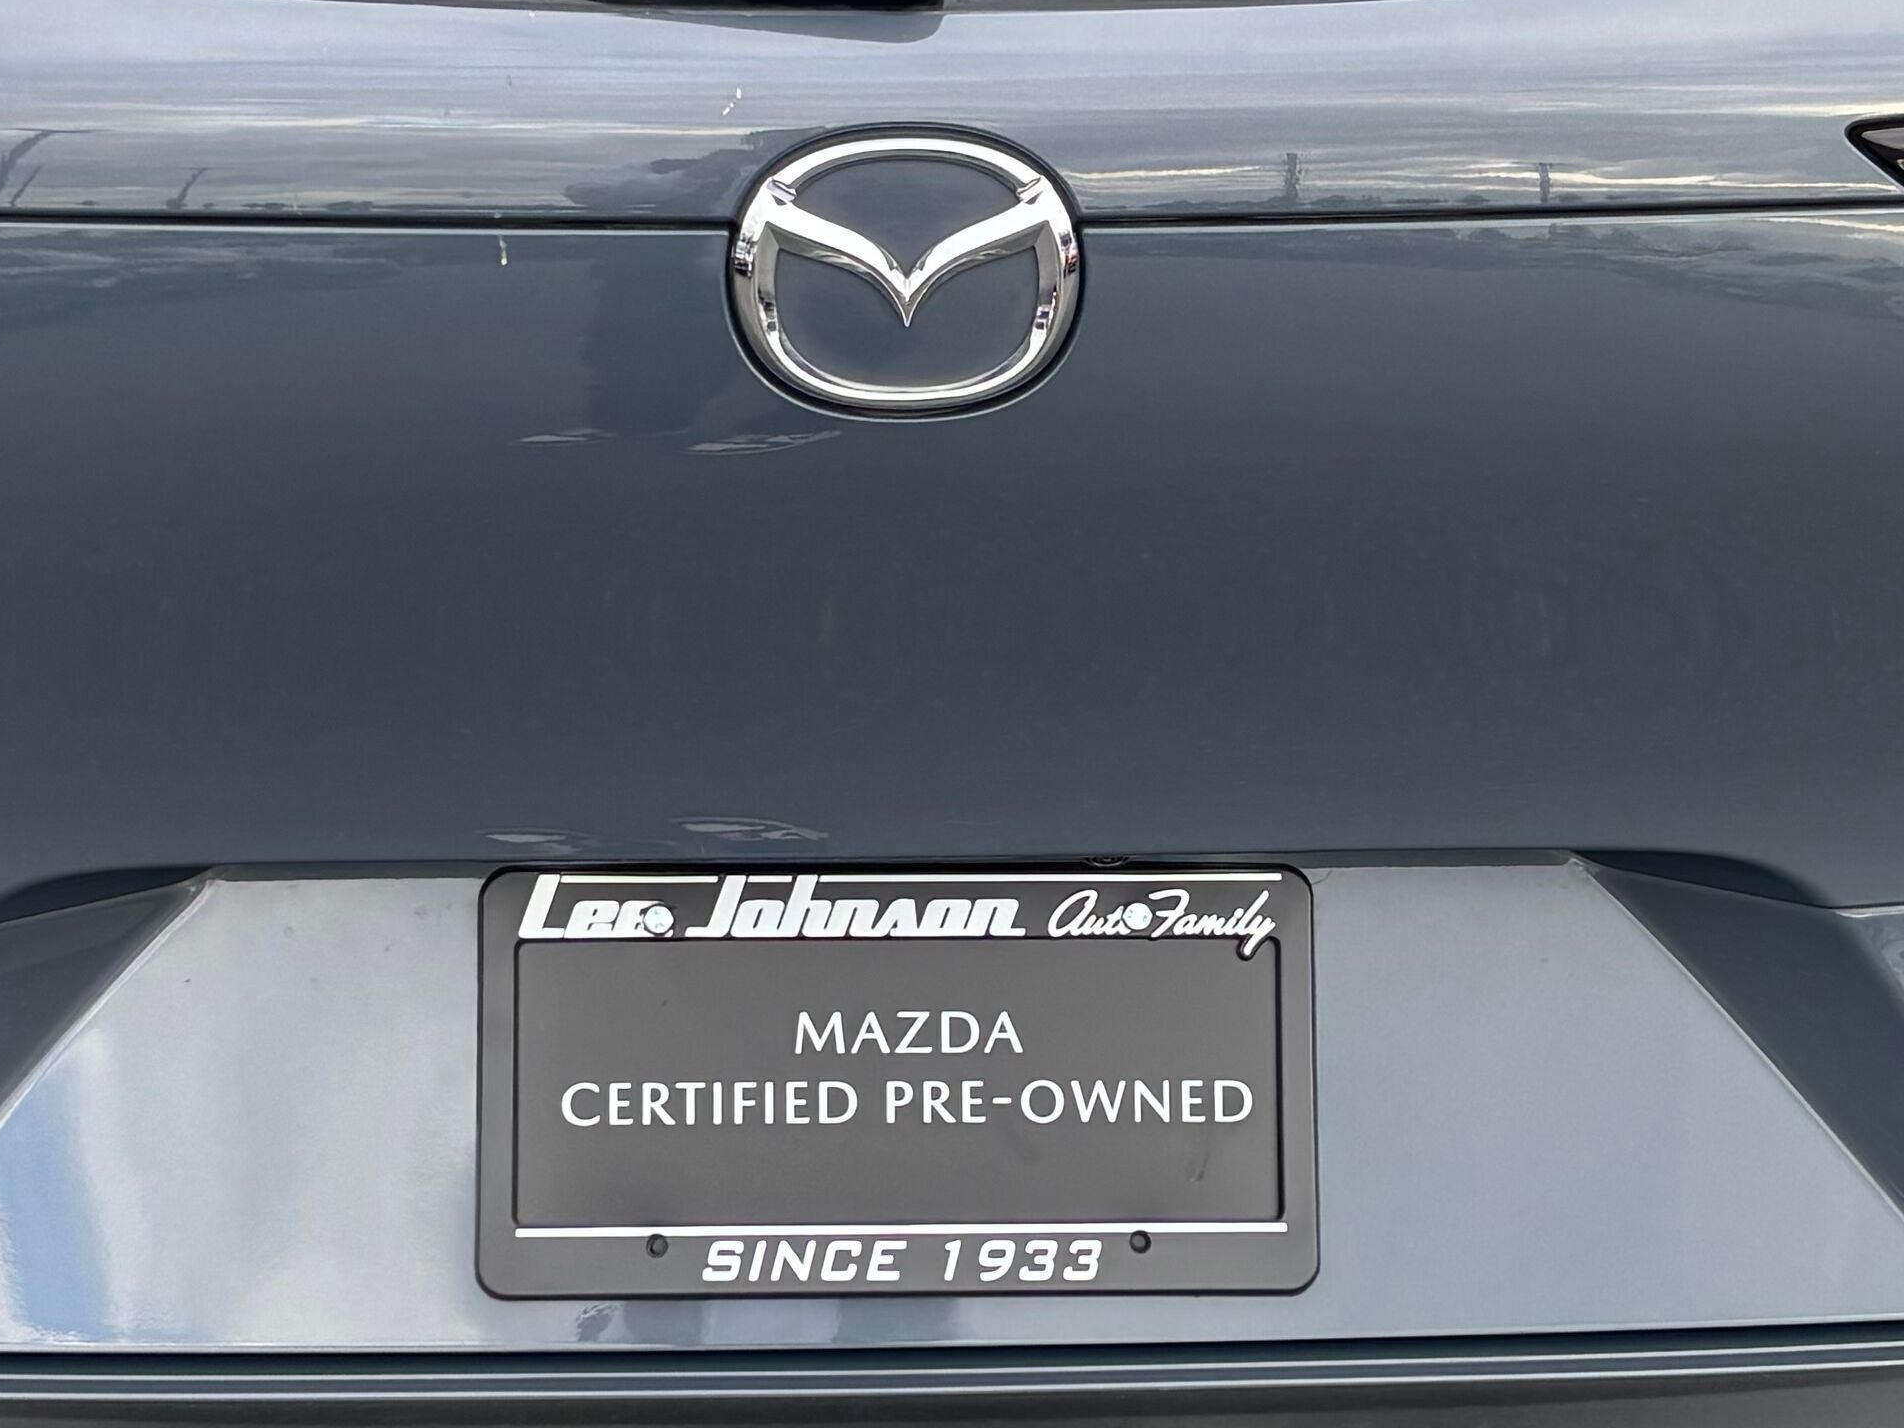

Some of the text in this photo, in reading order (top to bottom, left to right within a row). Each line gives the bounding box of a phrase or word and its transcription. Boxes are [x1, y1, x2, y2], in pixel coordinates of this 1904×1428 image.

[684, 873, 1027, 939] Johnson
[1047, 888, 1142, 938] Aut
[1148, 888, 1277, 957] Family
[793, 1010, 1025, 1055] MAZDA
[560, 1079, 1254, 1127] CERTIFIED PRE-OWNED
[701, 1239, 1104, 1283] SINCE 1933
